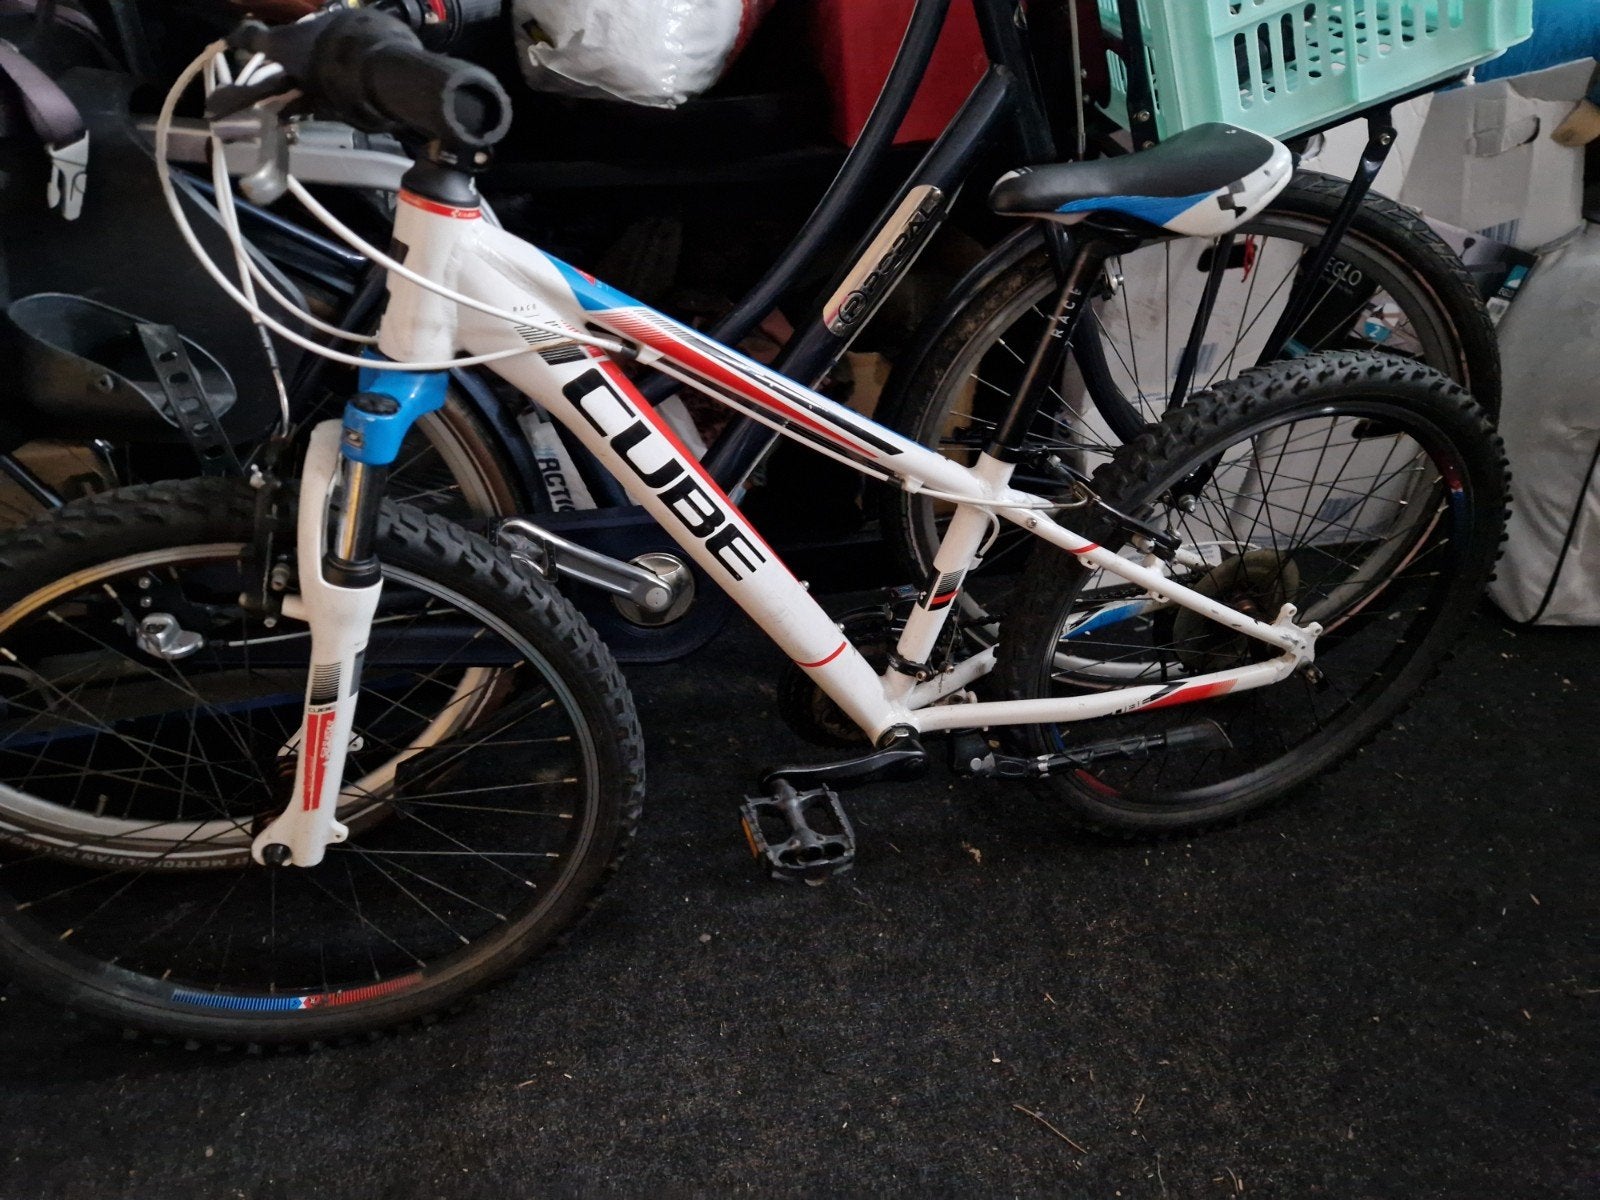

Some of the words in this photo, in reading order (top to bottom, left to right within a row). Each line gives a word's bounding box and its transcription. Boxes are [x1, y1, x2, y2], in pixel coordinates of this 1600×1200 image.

[1324, 257, 1363, 286] EGLO
[1050, 287, 1082, 338] RACE
[1368, 325, 1381, 338] 2
[562, 367, 767, 582] CUBE
